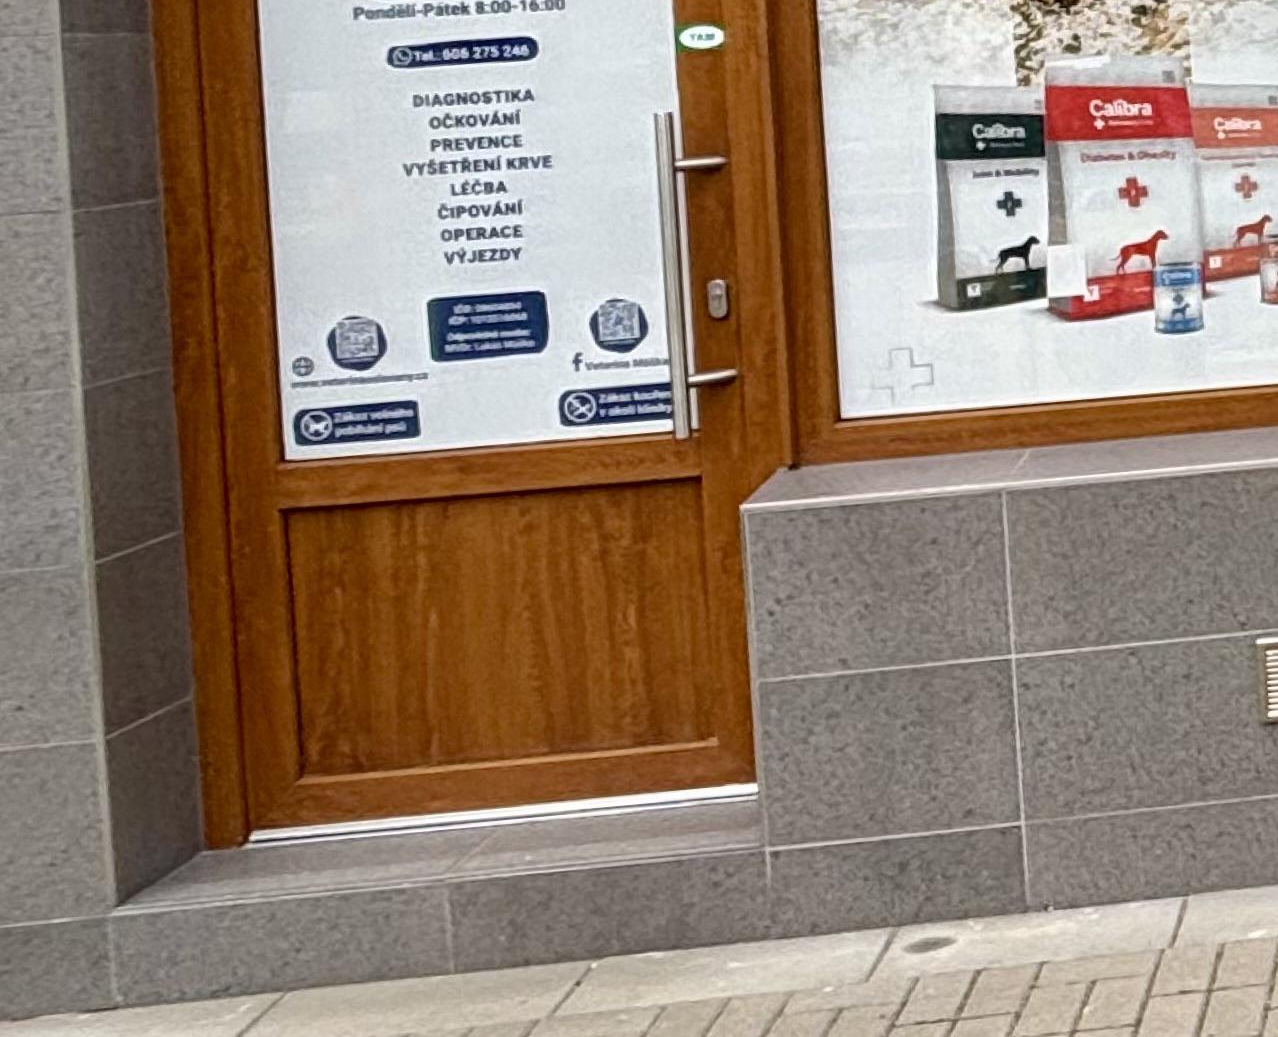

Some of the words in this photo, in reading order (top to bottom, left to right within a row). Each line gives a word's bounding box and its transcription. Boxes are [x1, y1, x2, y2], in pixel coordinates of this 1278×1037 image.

[412, 89, 535, 107] DIAGNOSTIKA
[1089, 98, 1153, 117] Calibra
[429, 109, 521, 129] OČKOVÁNÍ
[972, 123, 1026, 138] Calibra
[430, 134, 523, 152] PREVENCE
[403, 155, 502, 176] VYŠETŘENÍ
[506, 155, 554, 171] KRVE
[451, 179, 508, 196] LÉČBA
[437, 199, 523, 219] ČIPOVÁNÍ
[440, 225, 523, 242] OPERACE
[444, 247, 522, 265] VÝJEZDY
